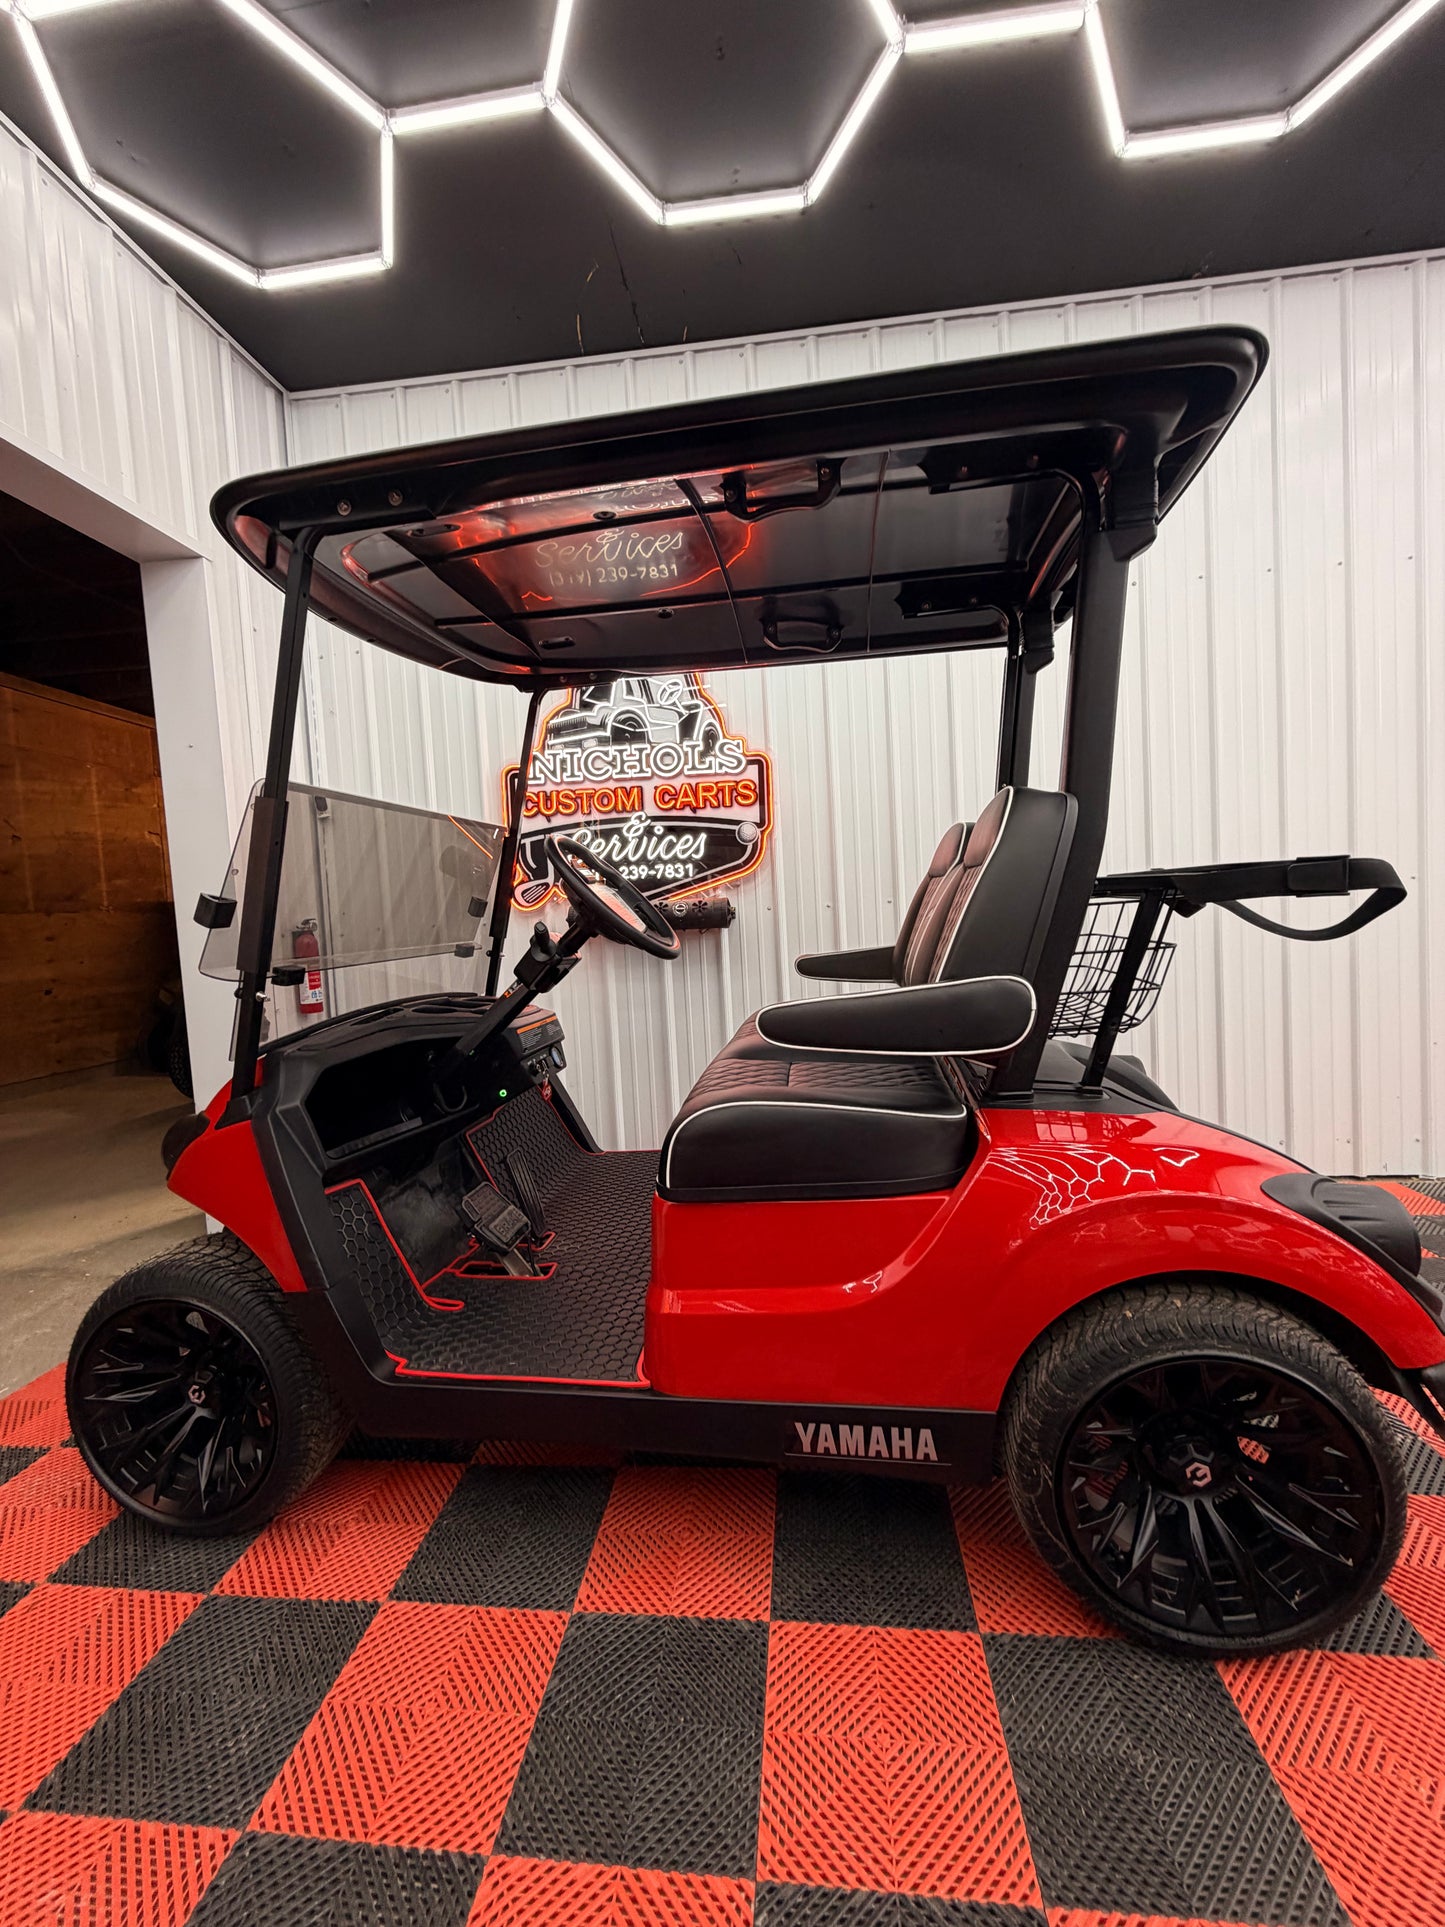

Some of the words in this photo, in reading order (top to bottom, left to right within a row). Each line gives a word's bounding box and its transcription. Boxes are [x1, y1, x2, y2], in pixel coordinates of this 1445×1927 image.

[534, 531, 684, 568] Services
[598, 563, 679, 584] 239-7831
[528, 739, 747, 784] NICHOLS
[523, 785, 643, 817] CUSTOM
[654, 779, 758, 812] CARTS
[622, 811, 651, 838] &
[618, 863, 694, 881] 239-7831
[794, 1422, 938, 1461] YAMAHA
